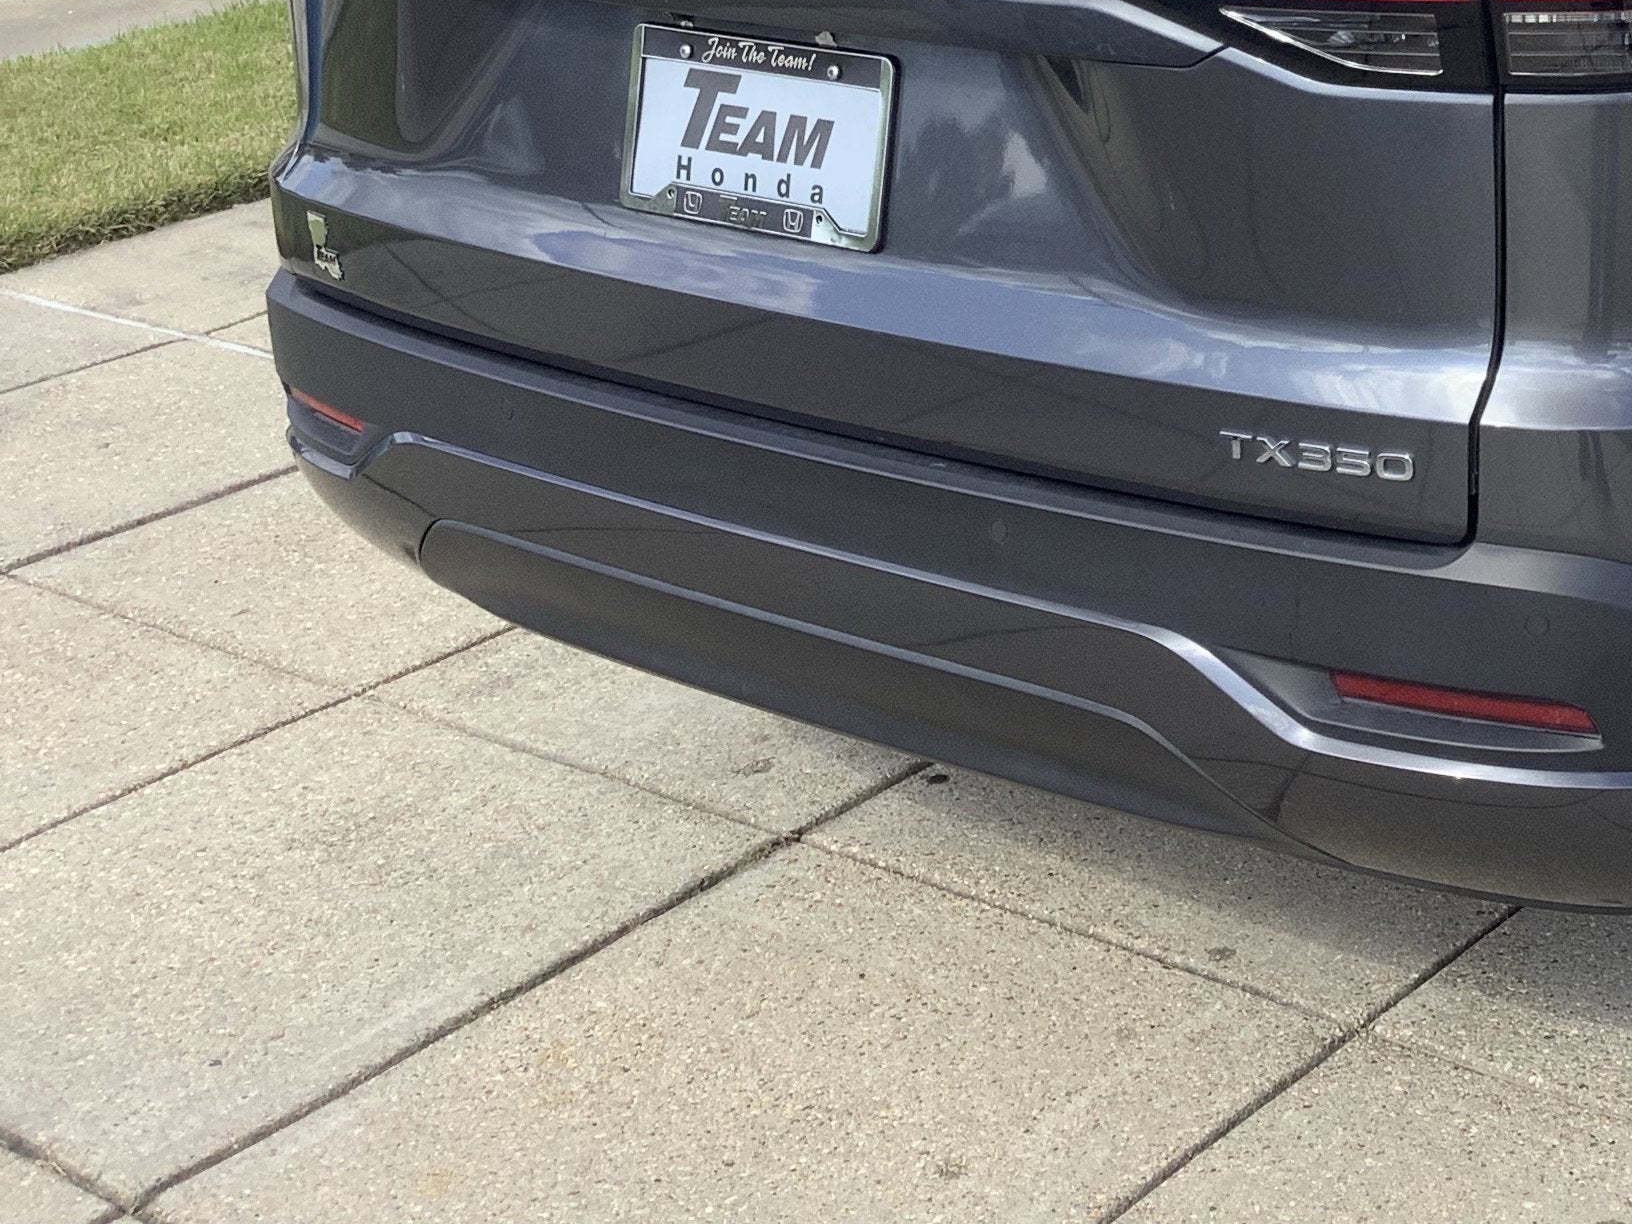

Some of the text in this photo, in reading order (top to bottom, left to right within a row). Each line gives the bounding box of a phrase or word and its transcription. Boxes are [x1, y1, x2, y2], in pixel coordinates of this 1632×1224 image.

[701, 37, 817, 72] Join The Team!
[680, 68, 835, 170] TEAM
[675, 155, 824, 205] Honda
[1218, 430, 1415, 482] TX350
